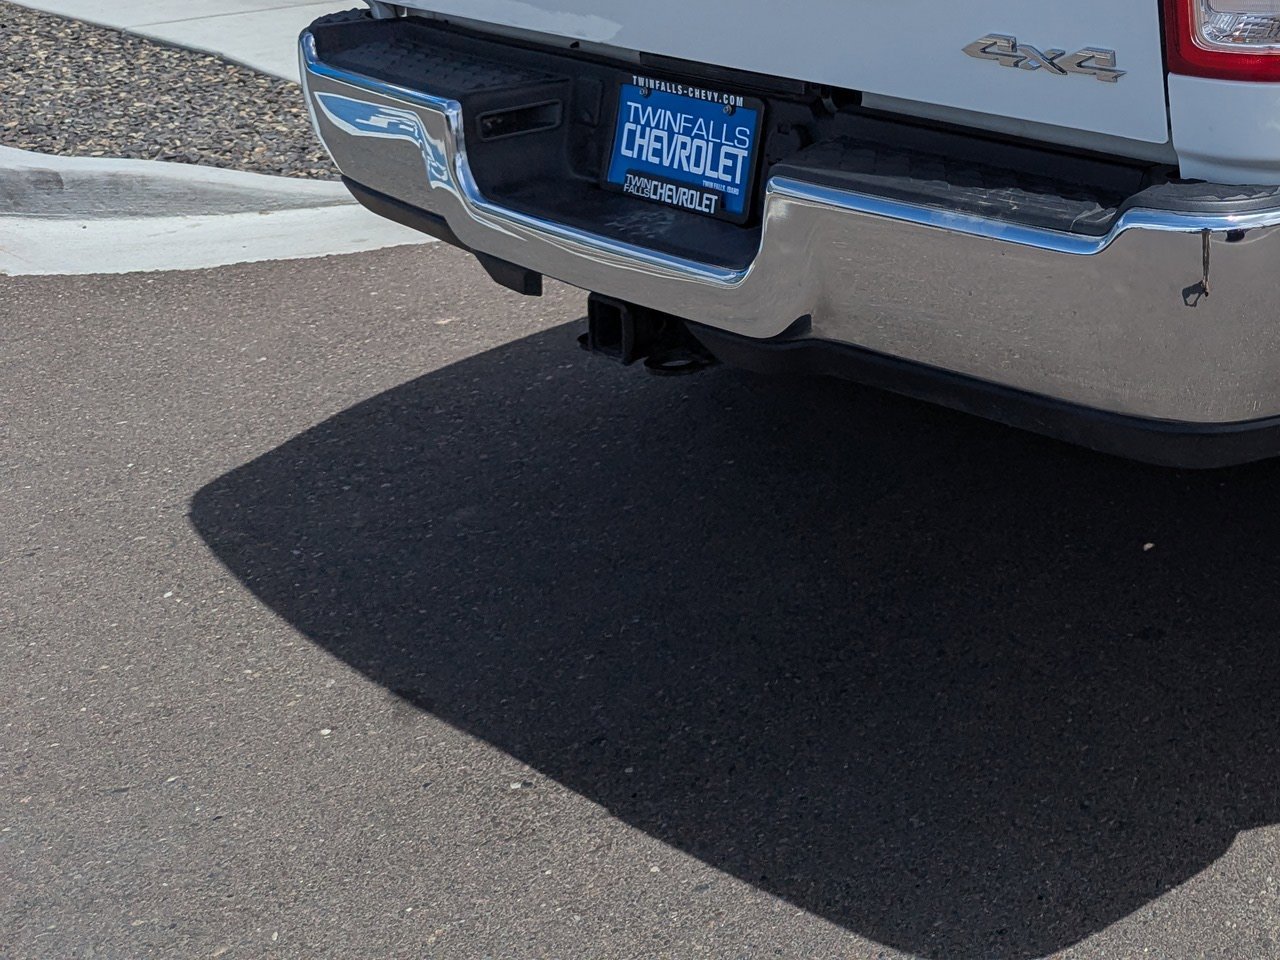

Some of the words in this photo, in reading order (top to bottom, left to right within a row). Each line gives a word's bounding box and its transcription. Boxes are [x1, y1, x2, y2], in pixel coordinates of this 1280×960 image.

[632, 76, 744, 106] TWINFALLS-CHEVY.COM
[626, 101, 750, 149] TWINFALLS
[620, 122, 748, 185] CHEVROLET
[623, 183, 650, 198] FALLS
[626, 174, 652, 189] TWIN
[650, 180, 718, 214] CHEVROLET
